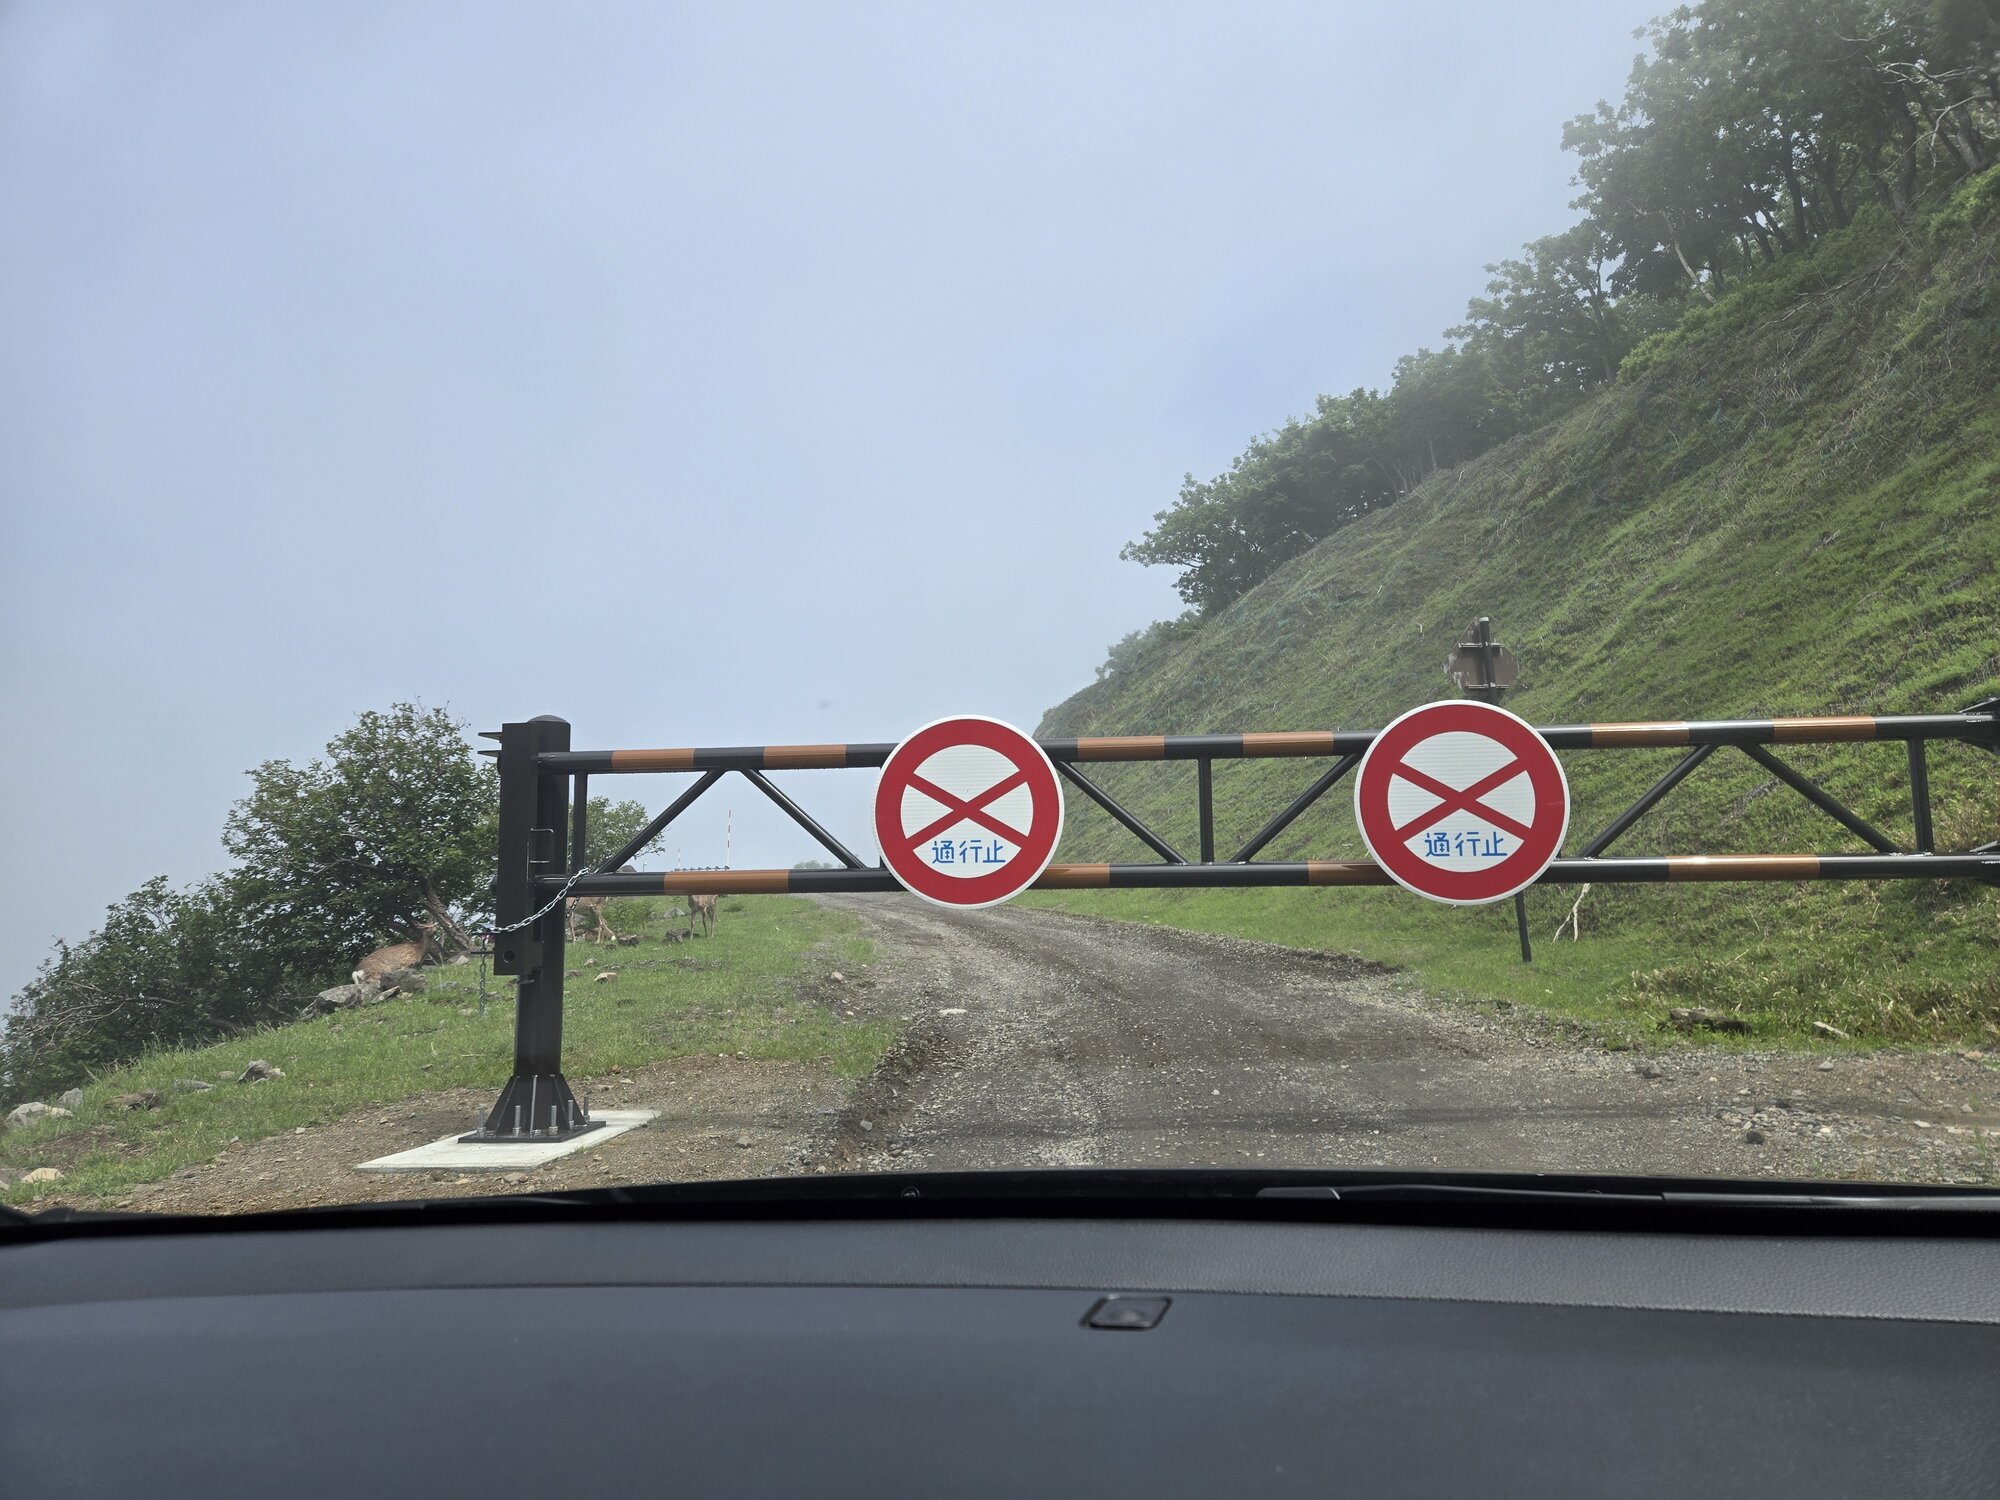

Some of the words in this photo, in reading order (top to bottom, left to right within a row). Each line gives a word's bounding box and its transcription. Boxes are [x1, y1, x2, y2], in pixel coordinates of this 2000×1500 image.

[931, 839, 1006, 864] 通行止
[1424, 831, 1507, 857] 通行止
